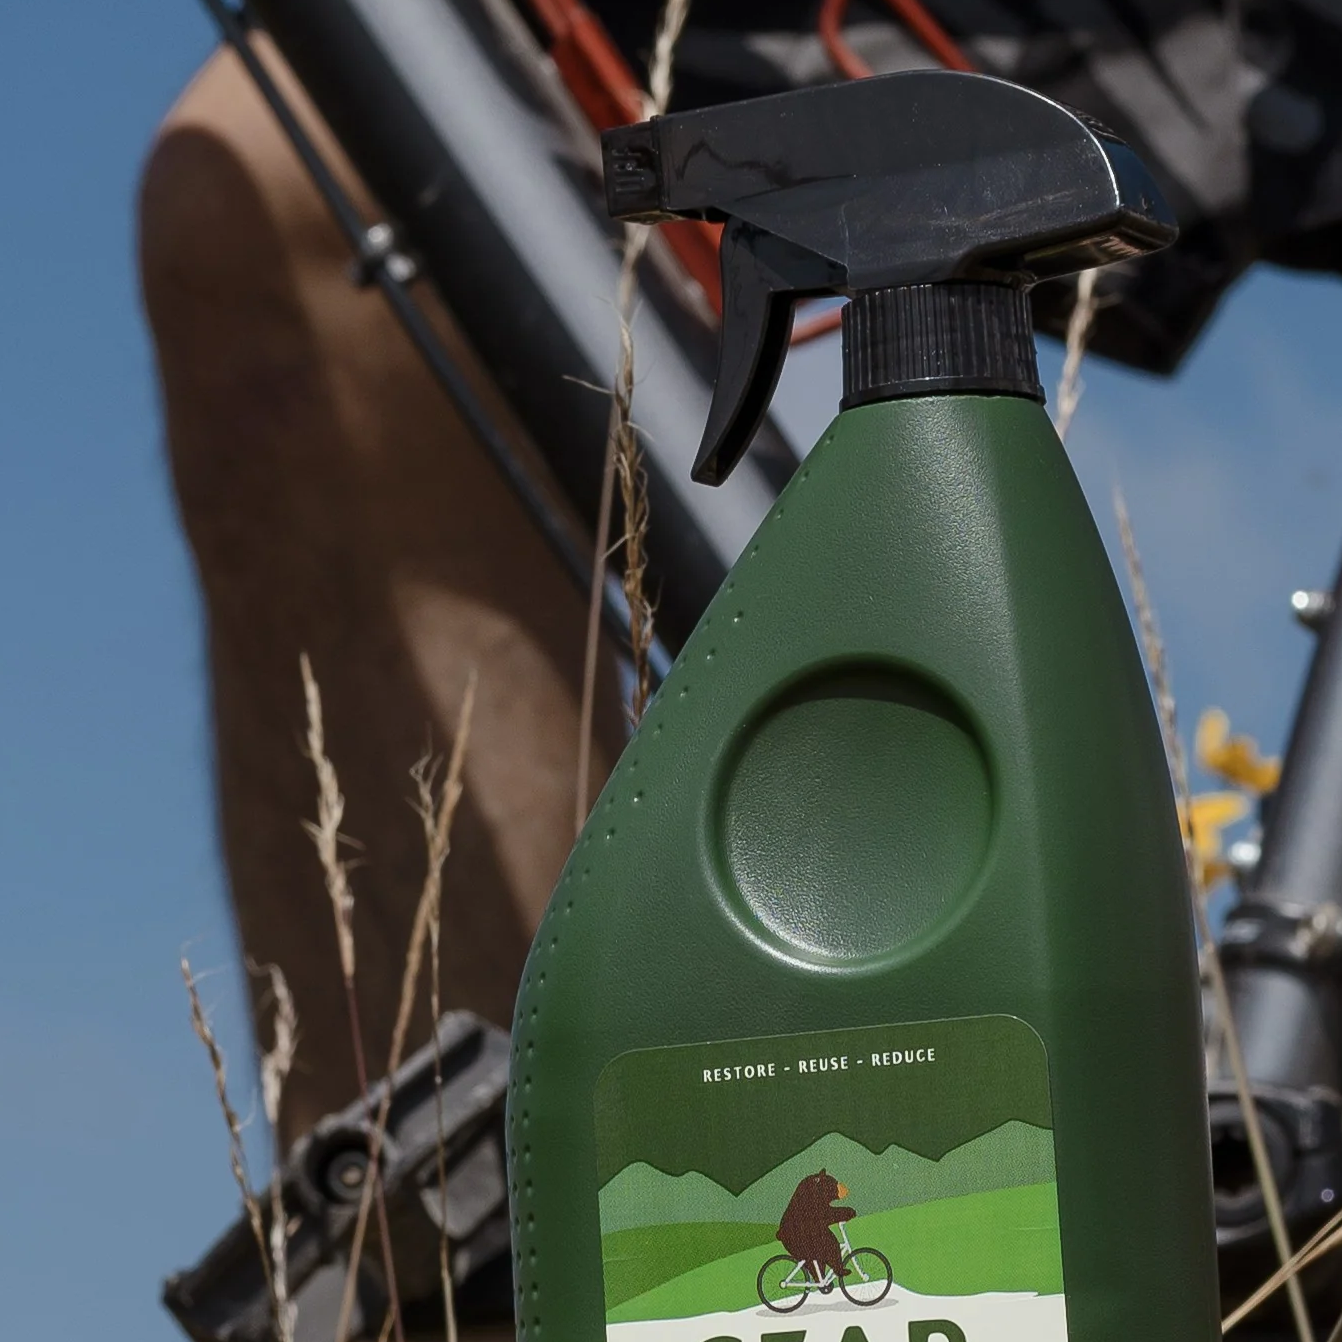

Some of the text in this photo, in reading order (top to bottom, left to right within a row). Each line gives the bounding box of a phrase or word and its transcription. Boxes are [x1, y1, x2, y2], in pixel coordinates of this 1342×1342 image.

[703, 1063, 776, 1083] RESTORE
[798, 1056, 849, 1073] REUSE
[871, 1048, 936, 1067] REDUCE
